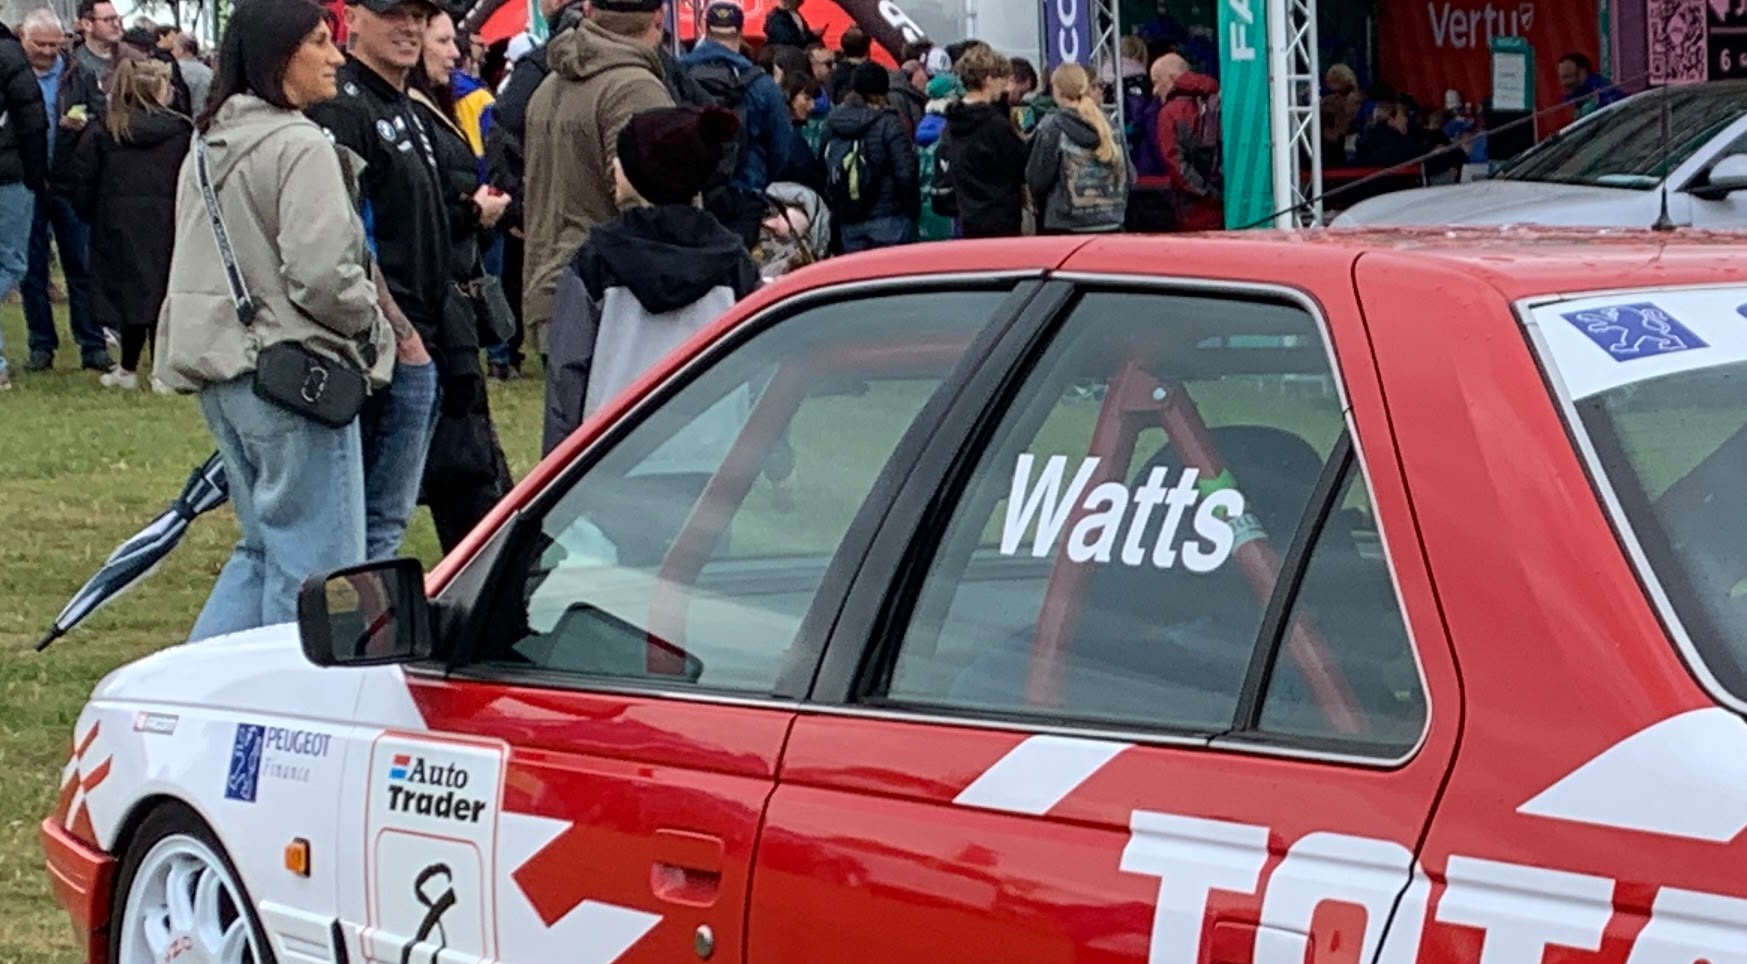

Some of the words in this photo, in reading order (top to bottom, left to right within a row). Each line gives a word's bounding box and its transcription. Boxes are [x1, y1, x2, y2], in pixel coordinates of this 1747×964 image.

[1427, 1, 1518, 49] Vertu
[1719, 48, 1732, 72] 6
[1000, 453, 1245, 573] Watts
[266, 726, 332, 757] PEUGEOT
[407, 757, 469, 790] Auto
[388, 784, 486, 824] Trader
